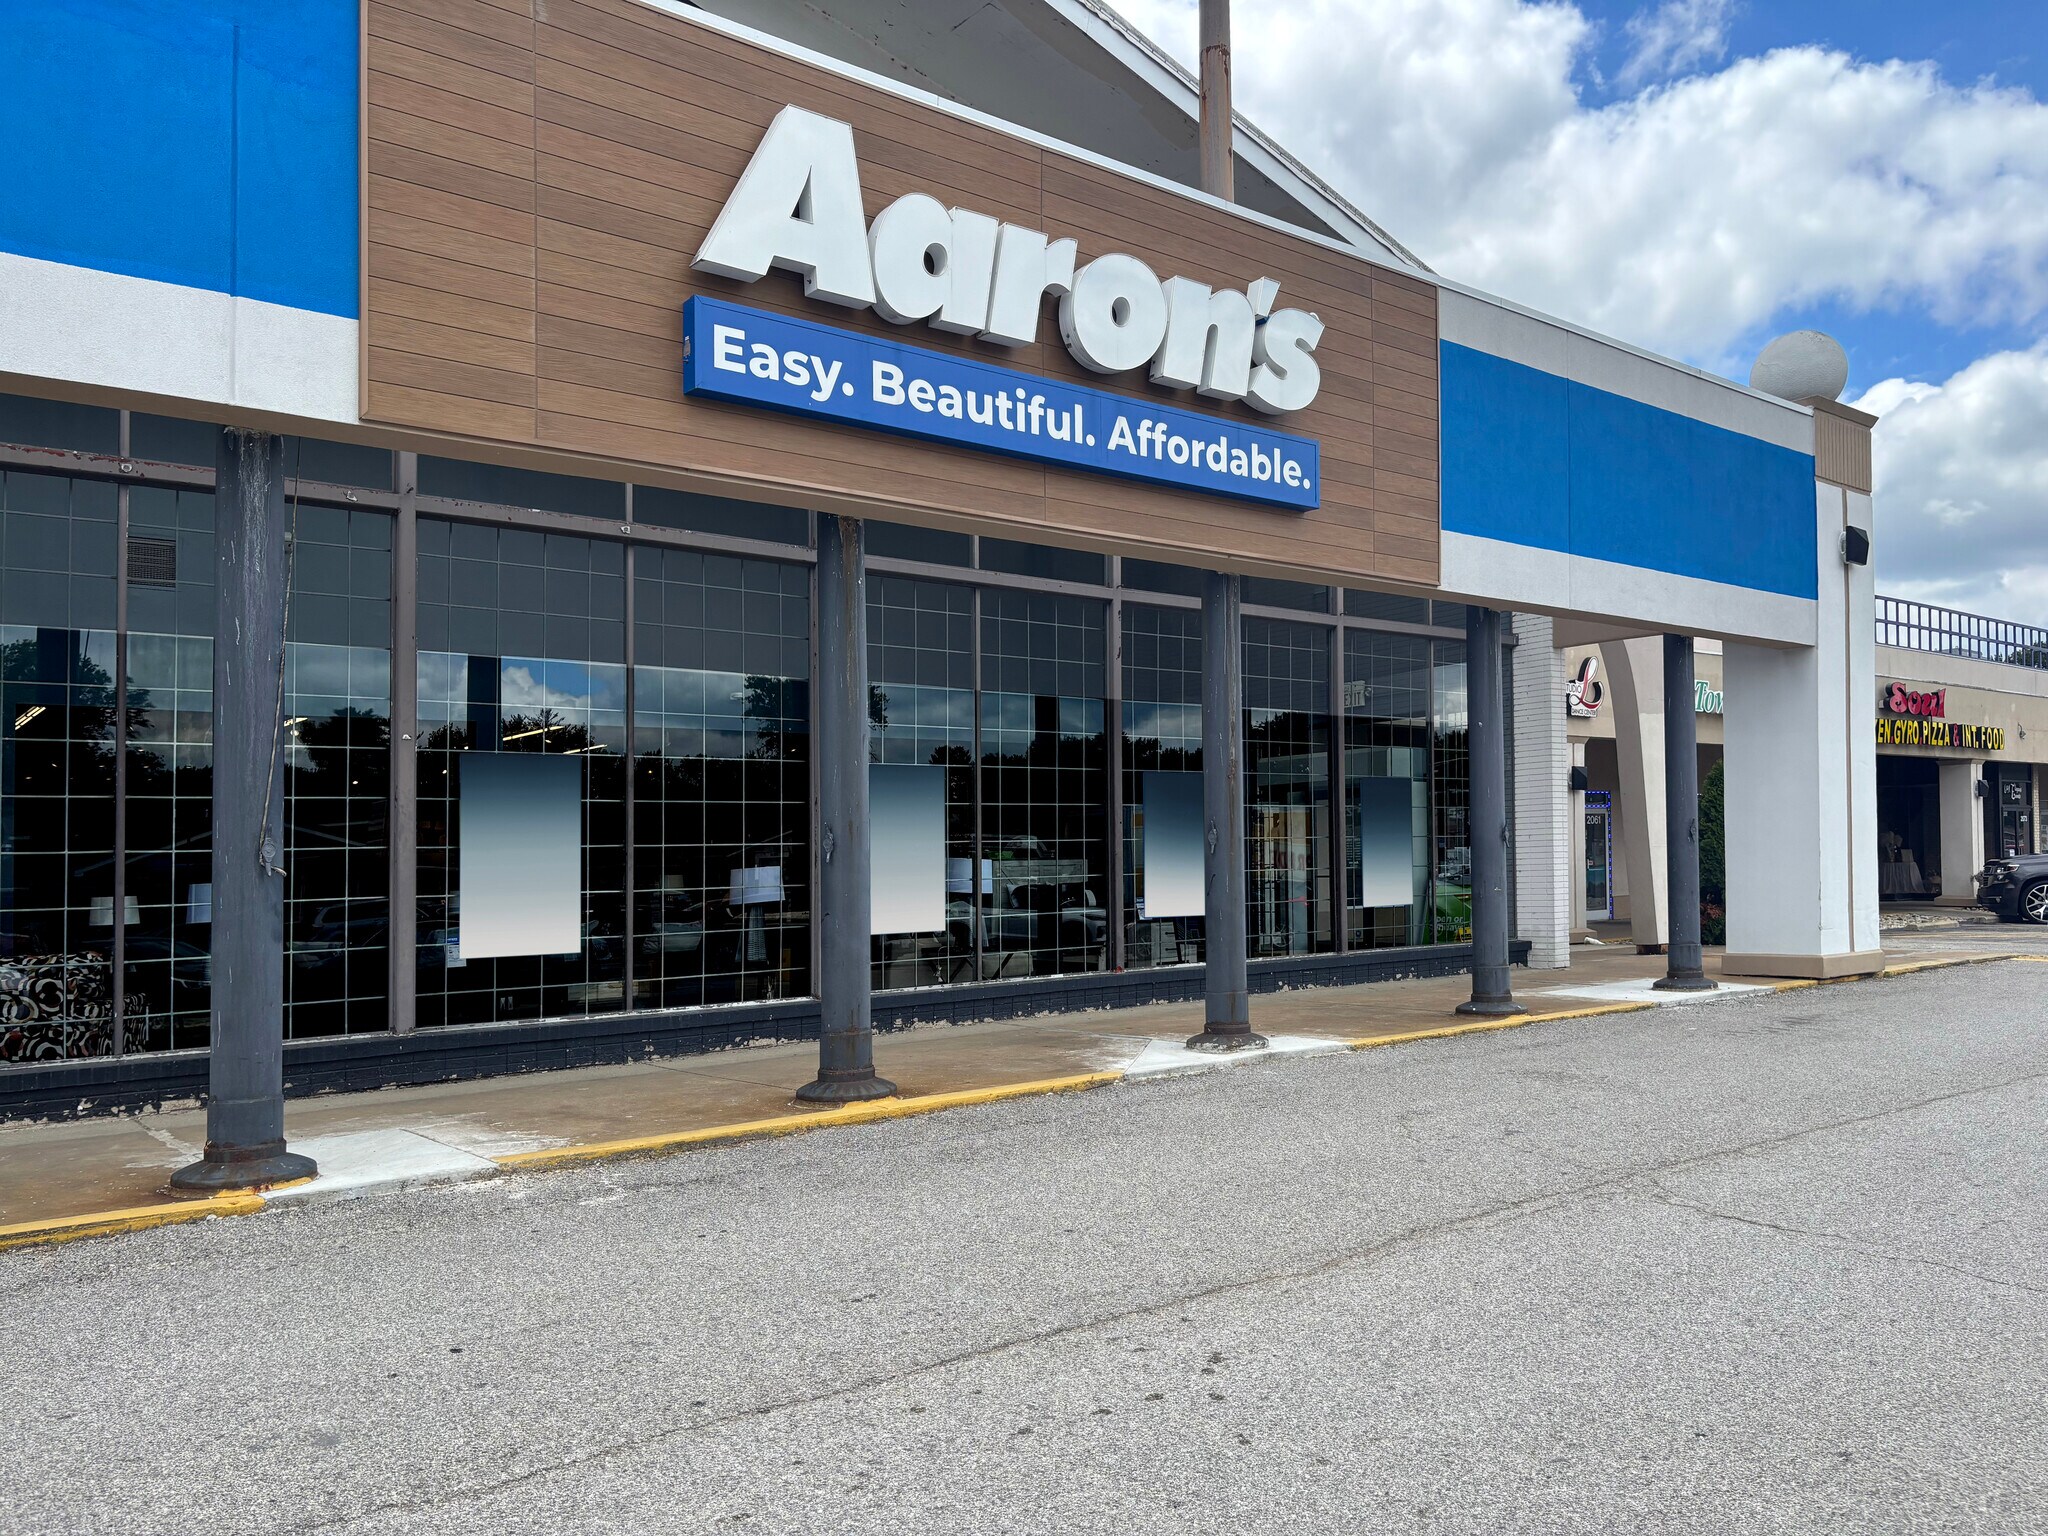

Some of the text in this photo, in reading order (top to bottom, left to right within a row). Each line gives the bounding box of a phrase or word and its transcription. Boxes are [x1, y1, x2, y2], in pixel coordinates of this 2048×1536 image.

[690, 103, 1325, 415] Aaron's
[713, 324, 1311, 490] Easy. Beautiful. Affordable.
[1889, 681, 1947, 718] Soul
[1953, 723, 1960, 747] &
[1962, 724, 1979, 749] INT.
[1981, 727, 2005, 750] FOOD
[1586, 815, 1601, 825] 2061
